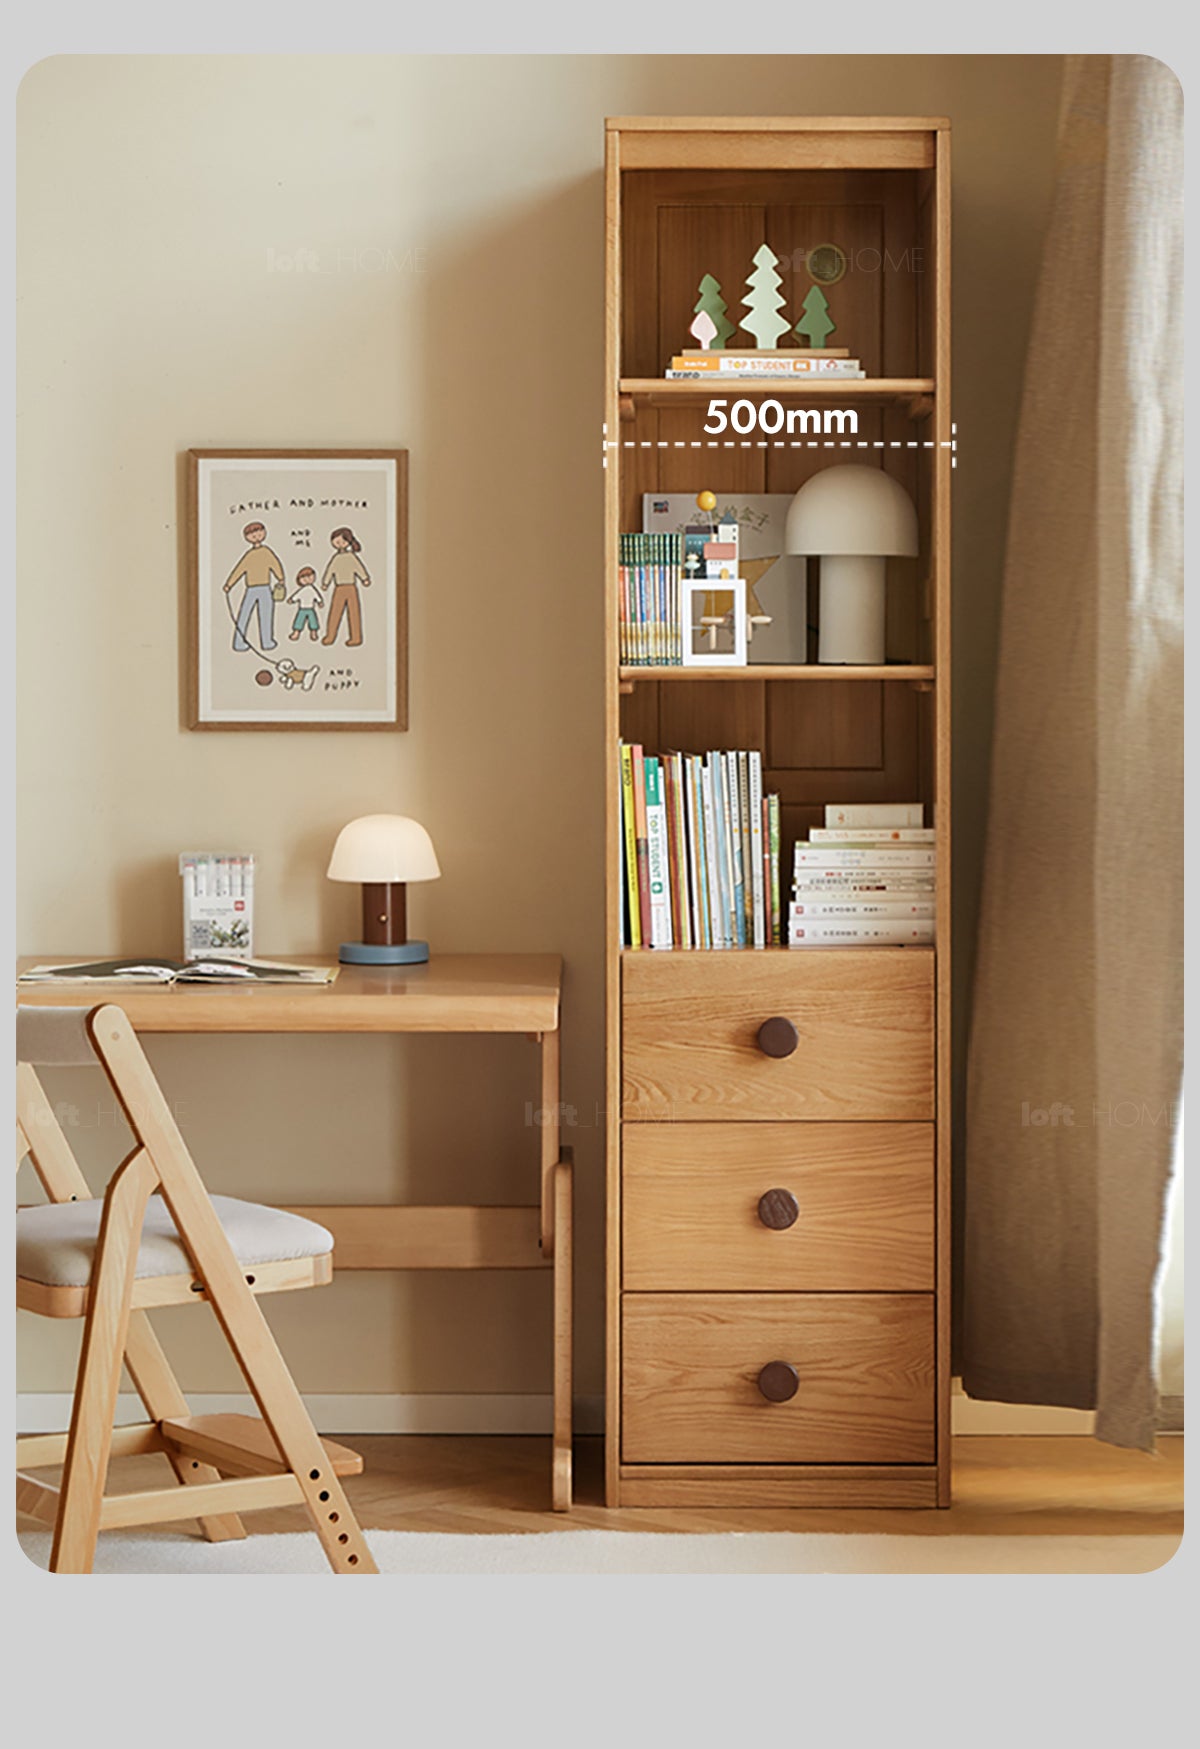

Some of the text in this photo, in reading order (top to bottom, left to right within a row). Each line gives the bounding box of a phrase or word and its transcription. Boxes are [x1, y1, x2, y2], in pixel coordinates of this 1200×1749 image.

[289, 498, 315, 509] AND
[320, 499, 370, 510] MOTHER
[290, 528, 311, 538] AND
[295, 539, 311, 548] ME
[329, 668, 353, 678] AND
[324, 680, 361, 692] PUPPY
